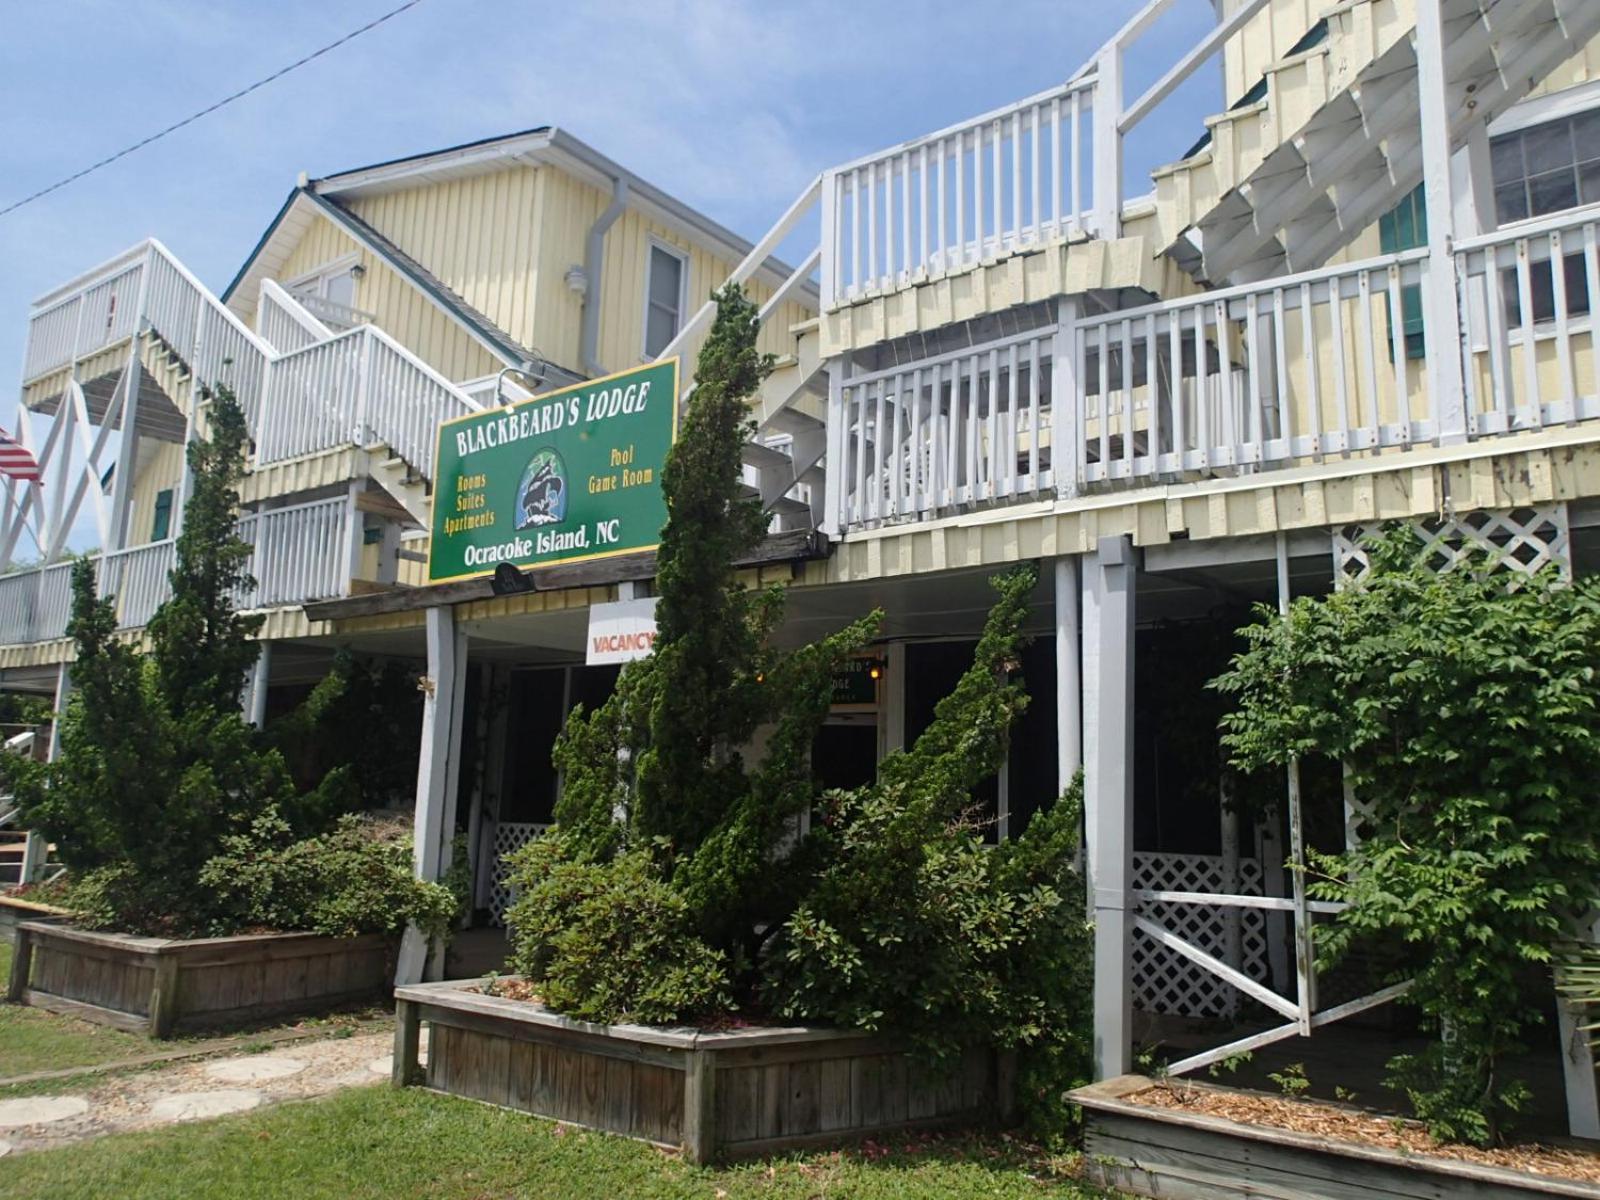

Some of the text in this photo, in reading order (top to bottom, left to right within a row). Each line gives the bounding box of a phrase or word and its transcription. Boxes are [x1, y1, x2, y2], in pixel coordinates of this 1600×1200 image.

[456, 381, 651, 457] BLACKBEARD'S LODGE
[610, 444, 634, 467] Pool
[457, 474, 486, 491] Rooms
[589, 468, 652, 494] Game Room
[456, 492, 485, 511] Suites
[444, 511, 495, 537] Apartments
[464, 519, 619, 566] Ocracoke Island, NC
[593, 631, 656, 653] VACANCY
